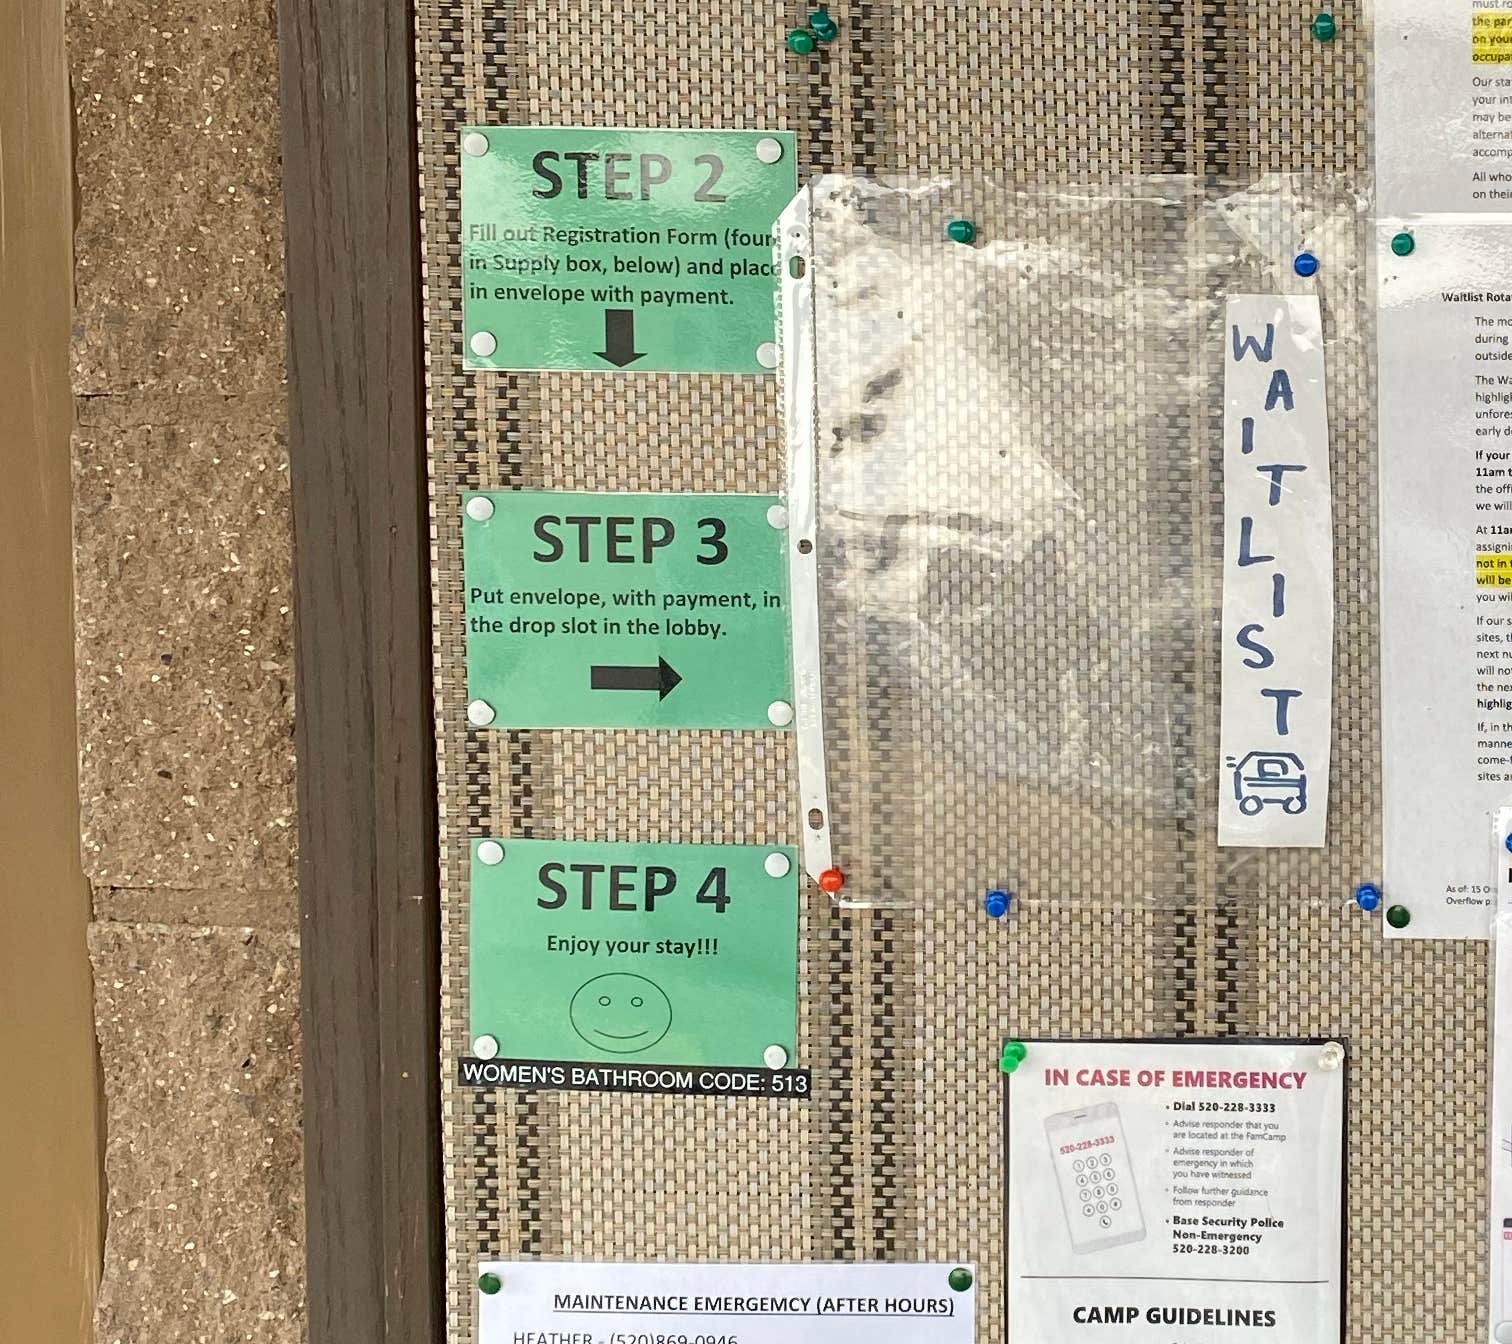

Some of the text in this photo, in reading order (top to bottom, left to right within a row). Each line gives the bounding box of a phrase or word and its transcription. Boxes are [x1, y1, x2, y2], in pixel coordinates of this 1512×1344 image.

[532, 150, 731, 203] STEP 2
[469, 281, 733, 308] in envelope with payment.
[1441, 292, 1483, 302] Waitlist
[533, 514, 728, 565] STEP 3
[470, 587, 784, 611] Put envelope, with payment, in
[469, 615, 726, 640] the drop slot in the lobby.
[1477, 771, 1501, 781] sites
[536, 861, 731, 913] STEP 4
[547, 934, 717, 959] Enjoy your stay!!!
[462, 1063, 811, 1095] WOMEN'S BATHROOM CODE: 513
[1044, 1068, 1307, 1089] IN CASE OF EMERGENCY
[1173, 1100, 1275, 1113] Dial 520-228-3333
[1172, 1215, 1284, 1229] Base Security Police
[1172, 1229, 1262, 1245] Non-Emergency
[1172, 1244, 1249, 1255] 520-228-3200
[554, 1294, 688, 1313] MAINTENANCE
[816, 1296, 879, 1316] (AFTER
[885, 1296, 954, 1315] HOURS)
[1072, 1306, 1275, 1327] CAMP GUIDELINES
